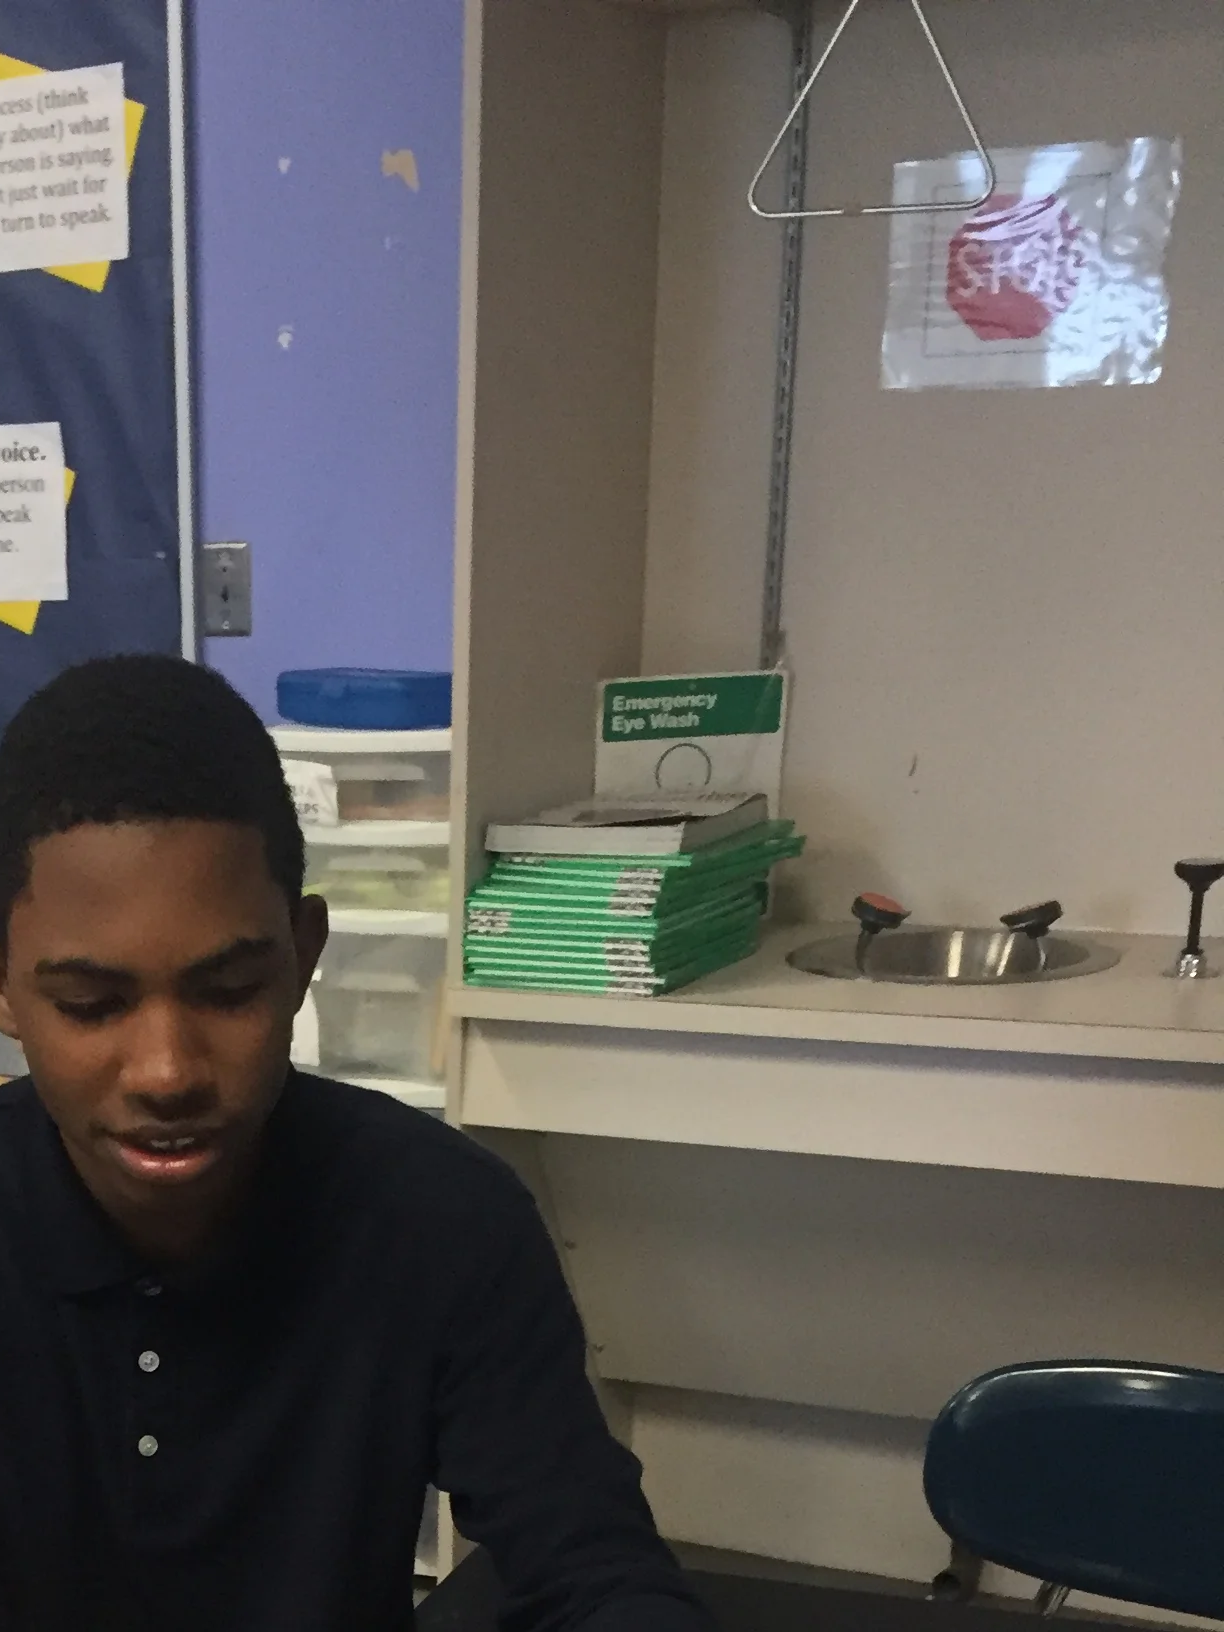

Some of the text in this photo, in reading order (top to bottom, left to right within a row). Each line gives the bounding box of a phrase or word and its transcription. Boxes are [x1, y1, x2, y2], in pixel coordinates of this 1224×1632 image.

[37, 87, 89, 115] (think
[10, 119, 64, 146] about)
[68, 115, 110, 136] what
[39, 150, 54, 171] is
[7, 182, 38, 207] just
[42, 179, 78, 200] wait
[82, 175, 107, 196] for
[0, 213, 34, 235] turn
[37, 209, 56, 229] to
[612, 693, 718, 712] Emergency
[611, 712, 700, 734] Eye Wash
